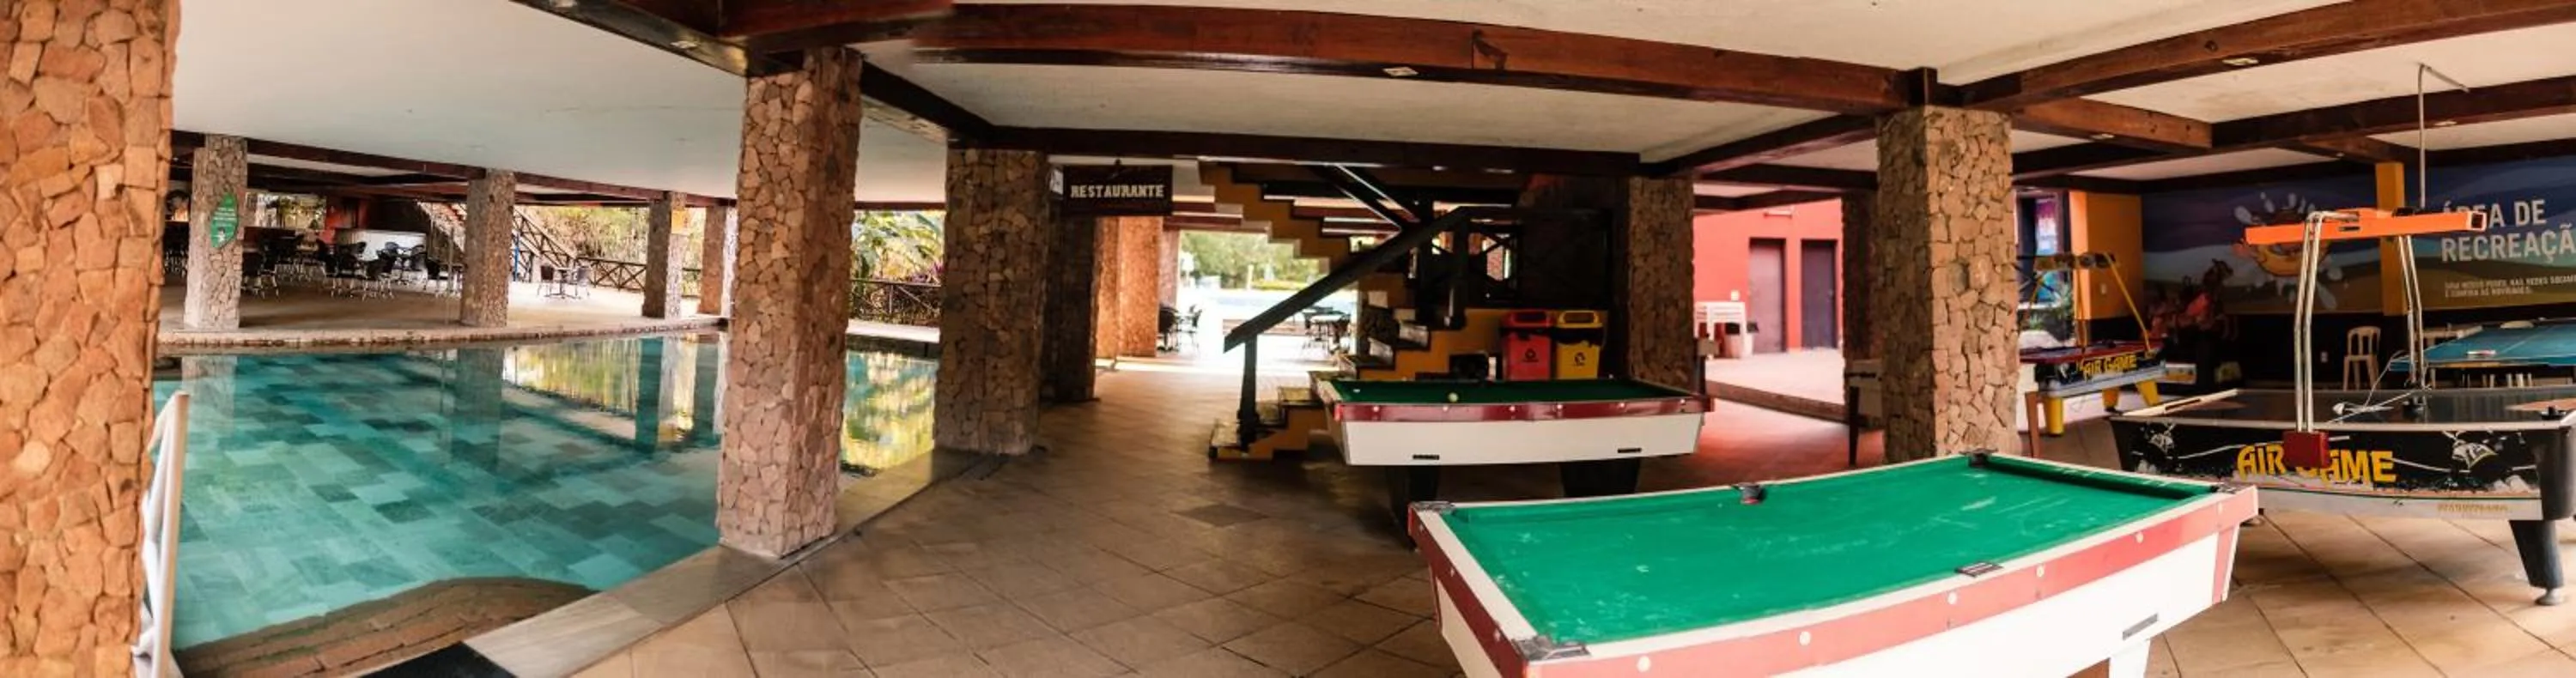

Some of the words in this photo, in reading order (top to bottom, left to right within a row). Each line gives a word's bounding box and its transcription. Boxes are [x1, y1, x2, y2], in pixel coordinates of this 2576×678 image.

[1070, 184, 1164, 198] RESTAURANTE
[2514, 199, 2547, 227] DE
[2104, 354, 2137, 375] GAME
[2237, 444, 2286, 480] AIR
